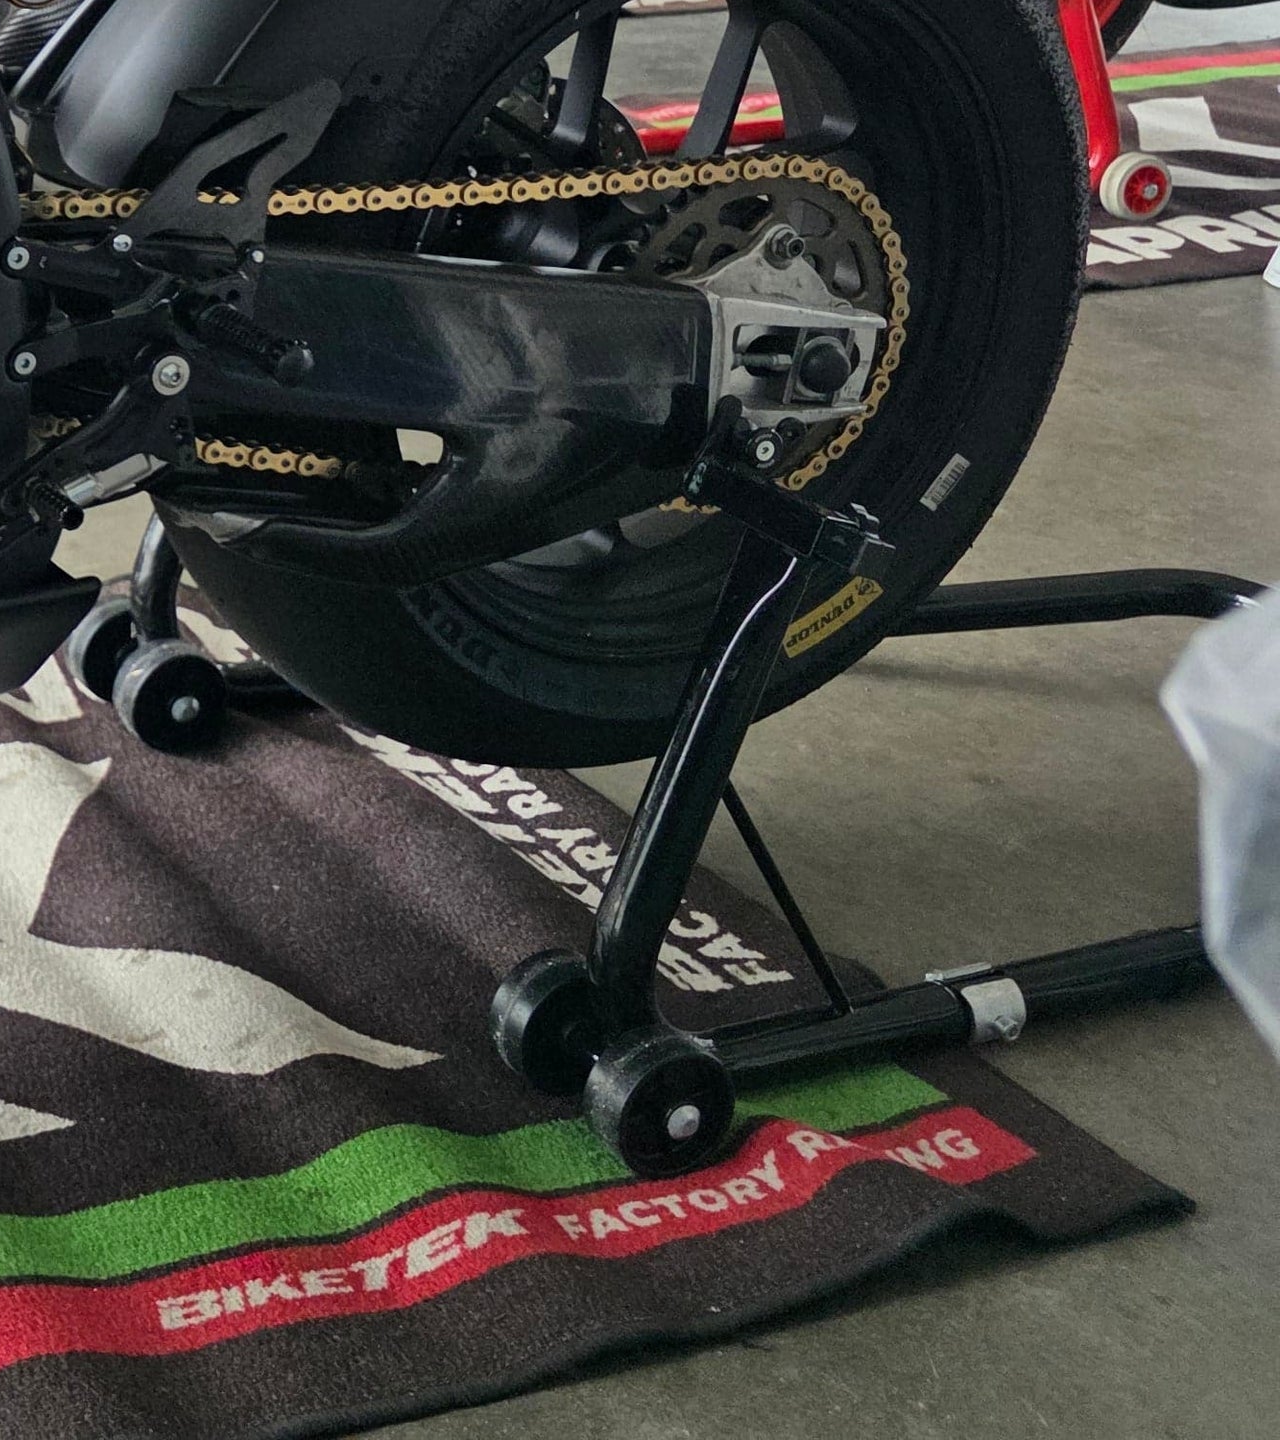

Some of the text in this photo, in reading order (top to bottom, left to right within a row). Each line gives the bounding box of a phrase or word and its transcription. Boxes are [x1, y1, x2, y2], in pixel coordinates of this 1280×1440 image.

[785, 593, 856, 649] DUNLOP
[155, 1205, 529, 1332] BIKETEK
[552, 1147, 786, 1242] FACTORY
